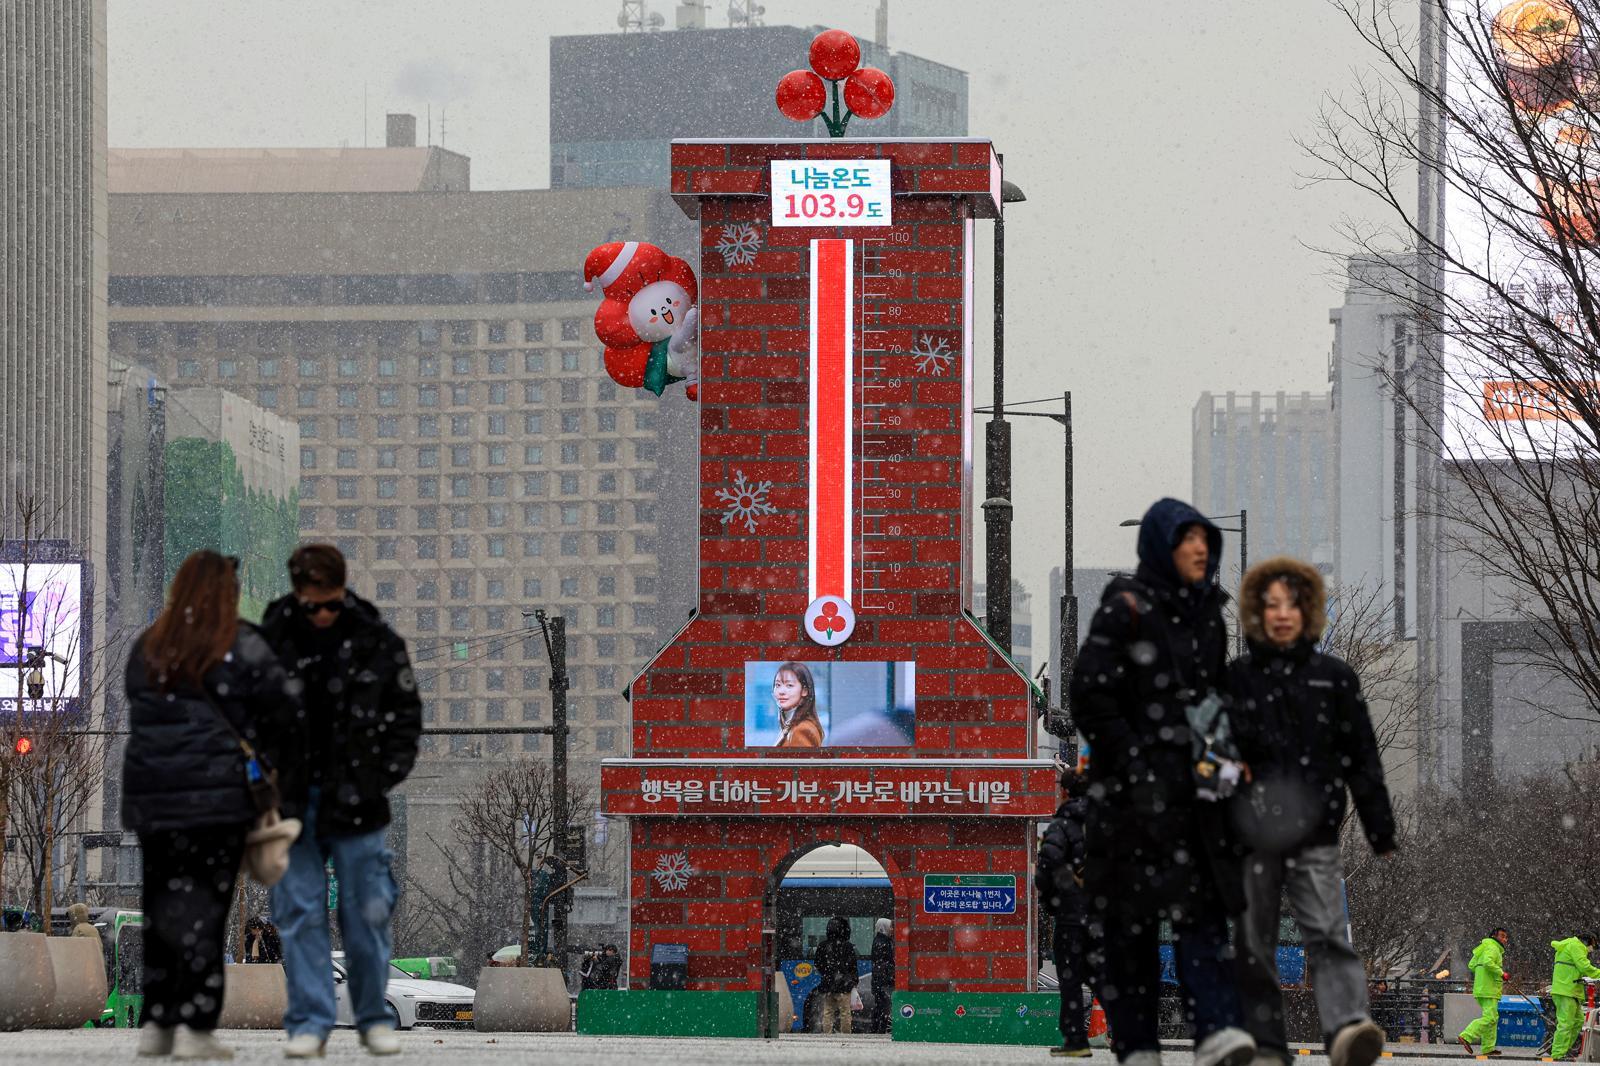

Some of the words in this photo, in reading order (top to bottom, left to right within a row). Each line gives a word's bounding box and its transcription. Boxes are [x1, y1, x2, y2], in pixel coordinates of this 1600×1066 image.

[791, 167, 871, 190] 나눔온도
[888, 232, 909, 242] 100
[888, 268, 902, 278] 90
[888, 306, 902, 316] 80
[888, 344, 902, 354] 70
[888, 379, 902, 389] 60
[888, 416, 901, 426] 50
[888, 453, 901, 463] 40
[888, 489, 901, 499] 30
[888, 526, 901, 536] 20
[888, 563, 901, 573] 10
[887, 602, 895, 611] 0
[640, 779, 705, 803] 행복을
[709, 779, 773, 803] 더하는
[776, 780, 826, 804] 기부,
[831, 780, 896, 804] 기부로
[900, 781, 964, 804] 바꾸는
[968, 781, 1011, 804] 내일
[940, 890, 960, 898] 이곳은
[984, 890, 1001, 898] 1번지
[982, 901, 1004, 910] 입니다.
